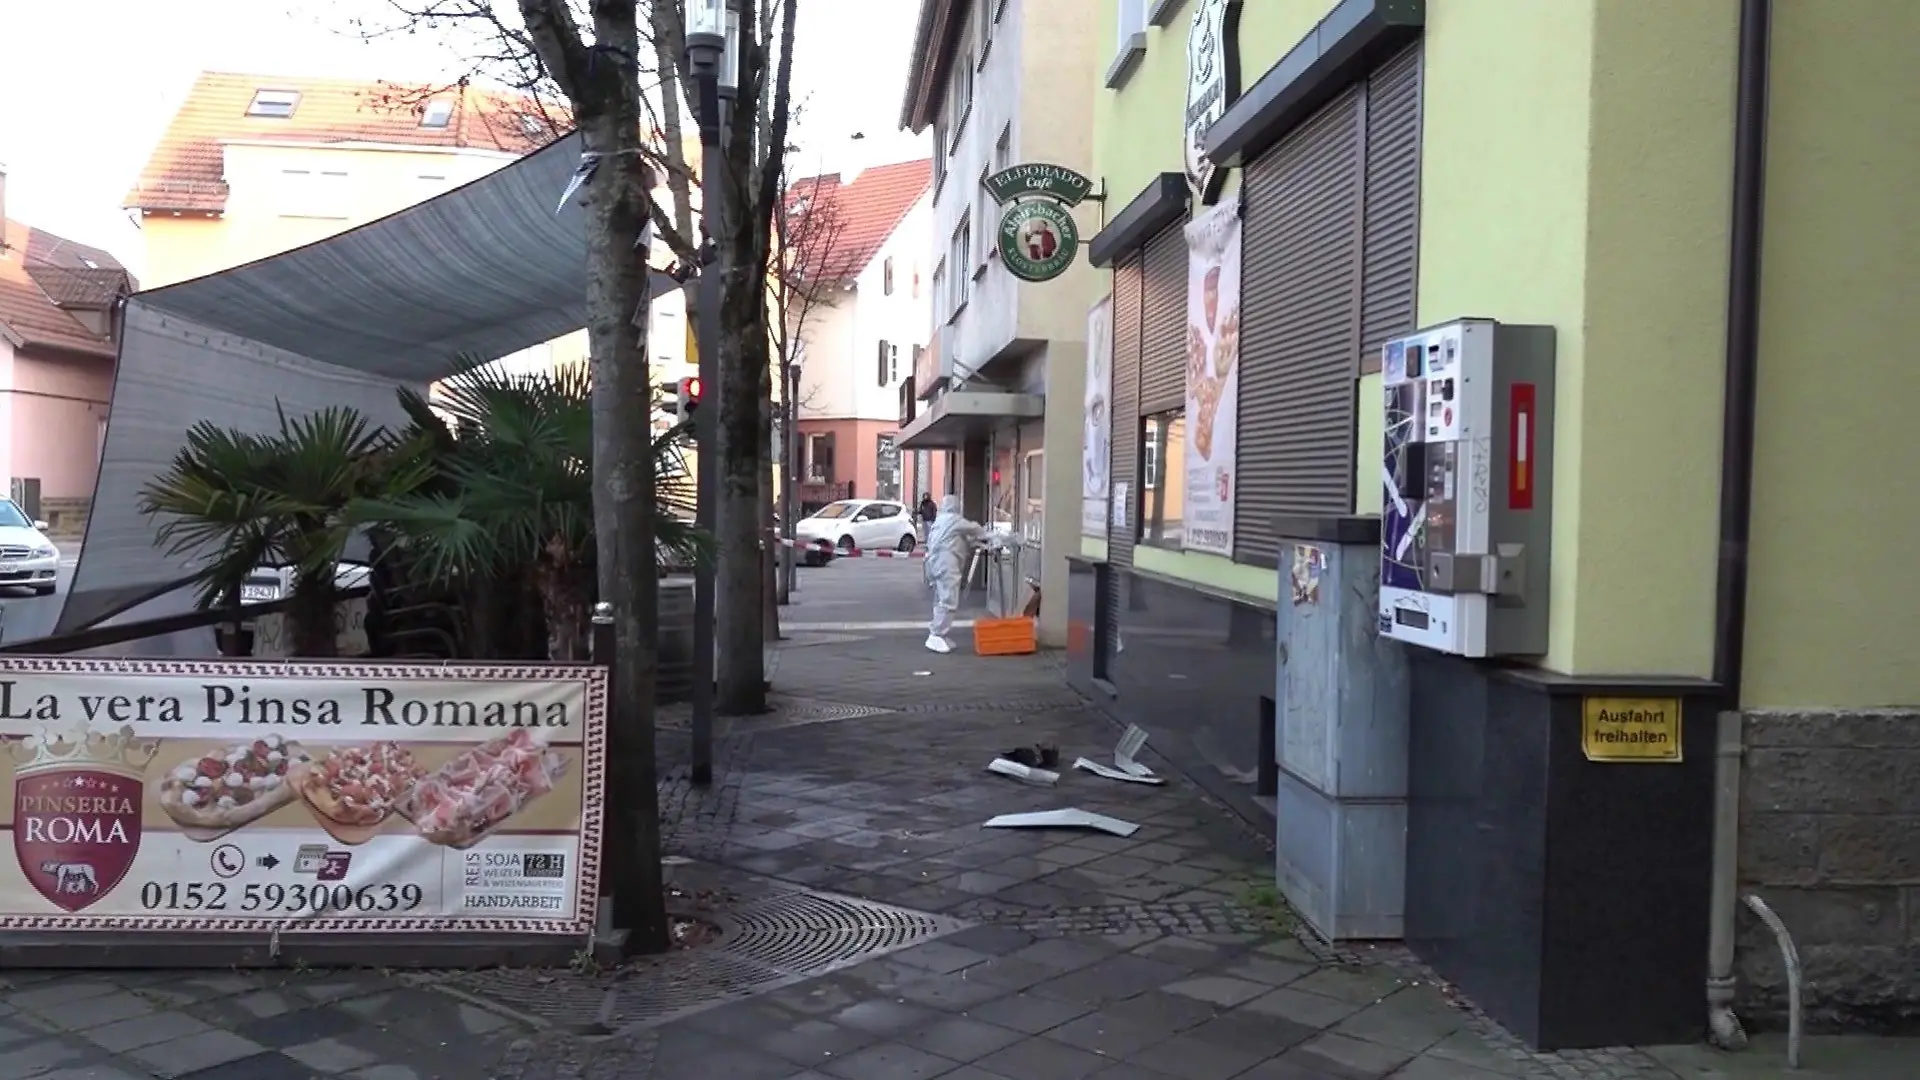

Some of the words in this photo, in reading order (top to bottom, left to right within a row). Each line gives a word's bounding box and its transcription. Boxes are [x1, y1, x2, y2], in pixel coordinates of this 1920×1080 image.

[994, 165, 1084, 188] ELDORADO
[0, 681, 60, 720] La
[78, 696, 183, 722] vera
[202, 685, 341, 725] Pinsa
[361, 688, 569, 727] Romana
[1599, 709, 1665, 723] Ausfahrt
[1594, 729, 1668, 743] freihalten
[21, 796, 134, 814] PINSERIA
[25, 816, 129, 843] ROMA
[465, 852, 481, 886] REIS
[485, 853, 521, 866] SOJA
[141, 881, 228, 910] 0152
[240, 883, 422, 912] 59300639
[465, 895, 562, 909] HANDARBEIT
